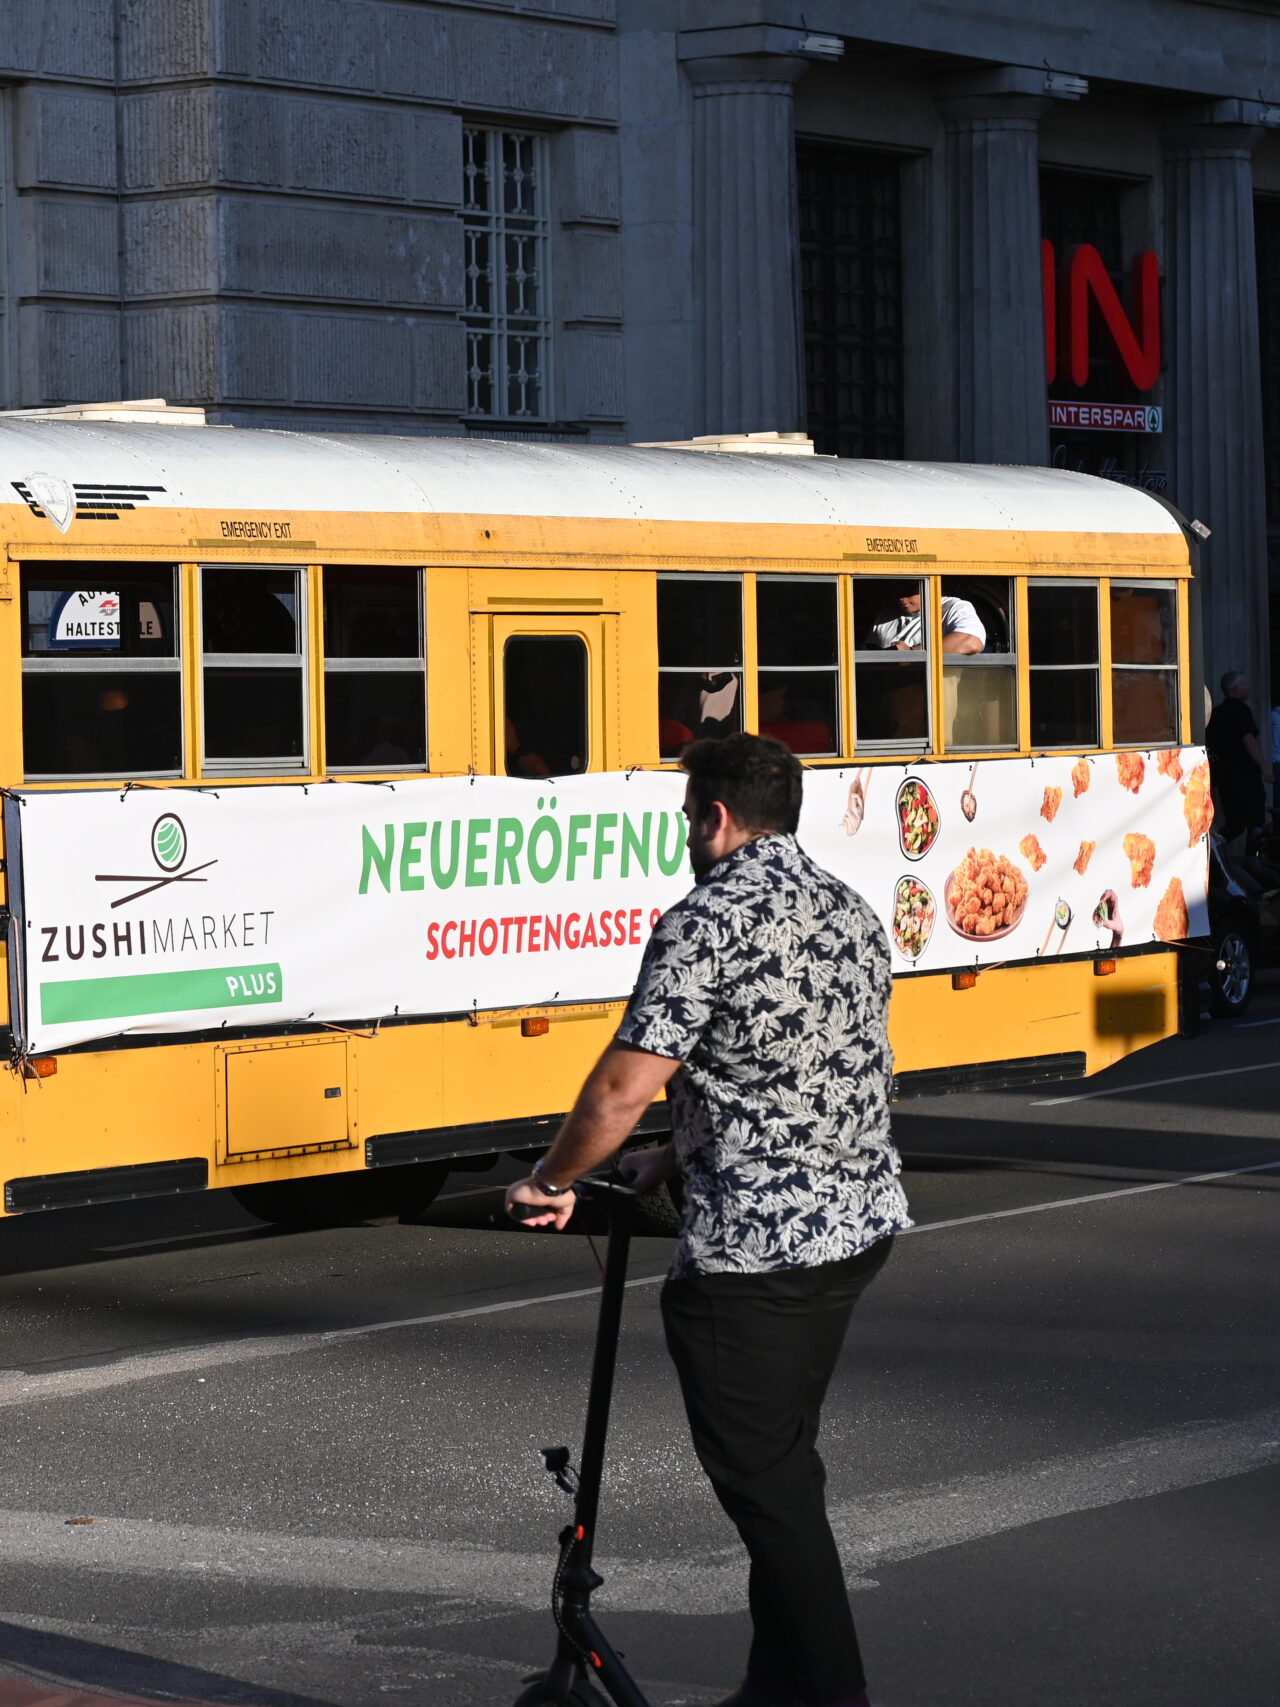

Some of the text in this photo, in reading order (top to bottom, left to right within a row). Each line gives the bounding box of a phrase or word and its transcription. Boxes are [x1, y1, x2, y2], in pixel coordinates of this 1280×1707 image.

[1052, 406, 1145, 426] INTERSPAR
[220, 521, 292, 538] EMERGENCY EXIT
[866, 537, 919, 553] EMERGENCY EXIT
[358, 796, 695, 894] NEUERÖFFNU
[426, 908, 642, 960] SCHOTTENGASSE
[225, 972, 277, 997] PLUS
